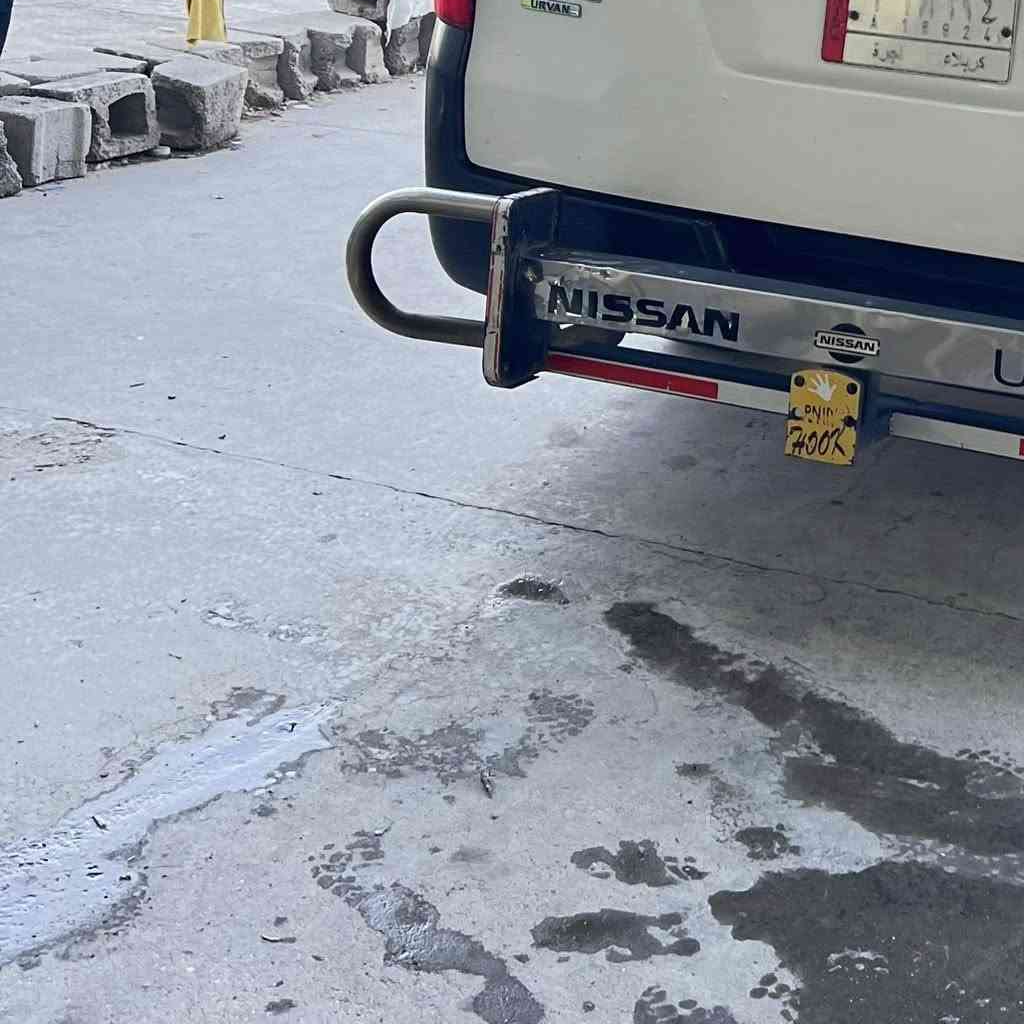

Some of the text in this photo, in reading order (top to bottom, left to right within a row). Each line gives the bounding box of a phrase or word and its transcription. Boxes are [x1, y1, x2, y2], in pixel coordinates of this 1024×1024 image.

[530, 0, 571, 14] URVAN
[547, 284, 740, 342] NISSAN
[819, 335, 876, 352] NISSAN
